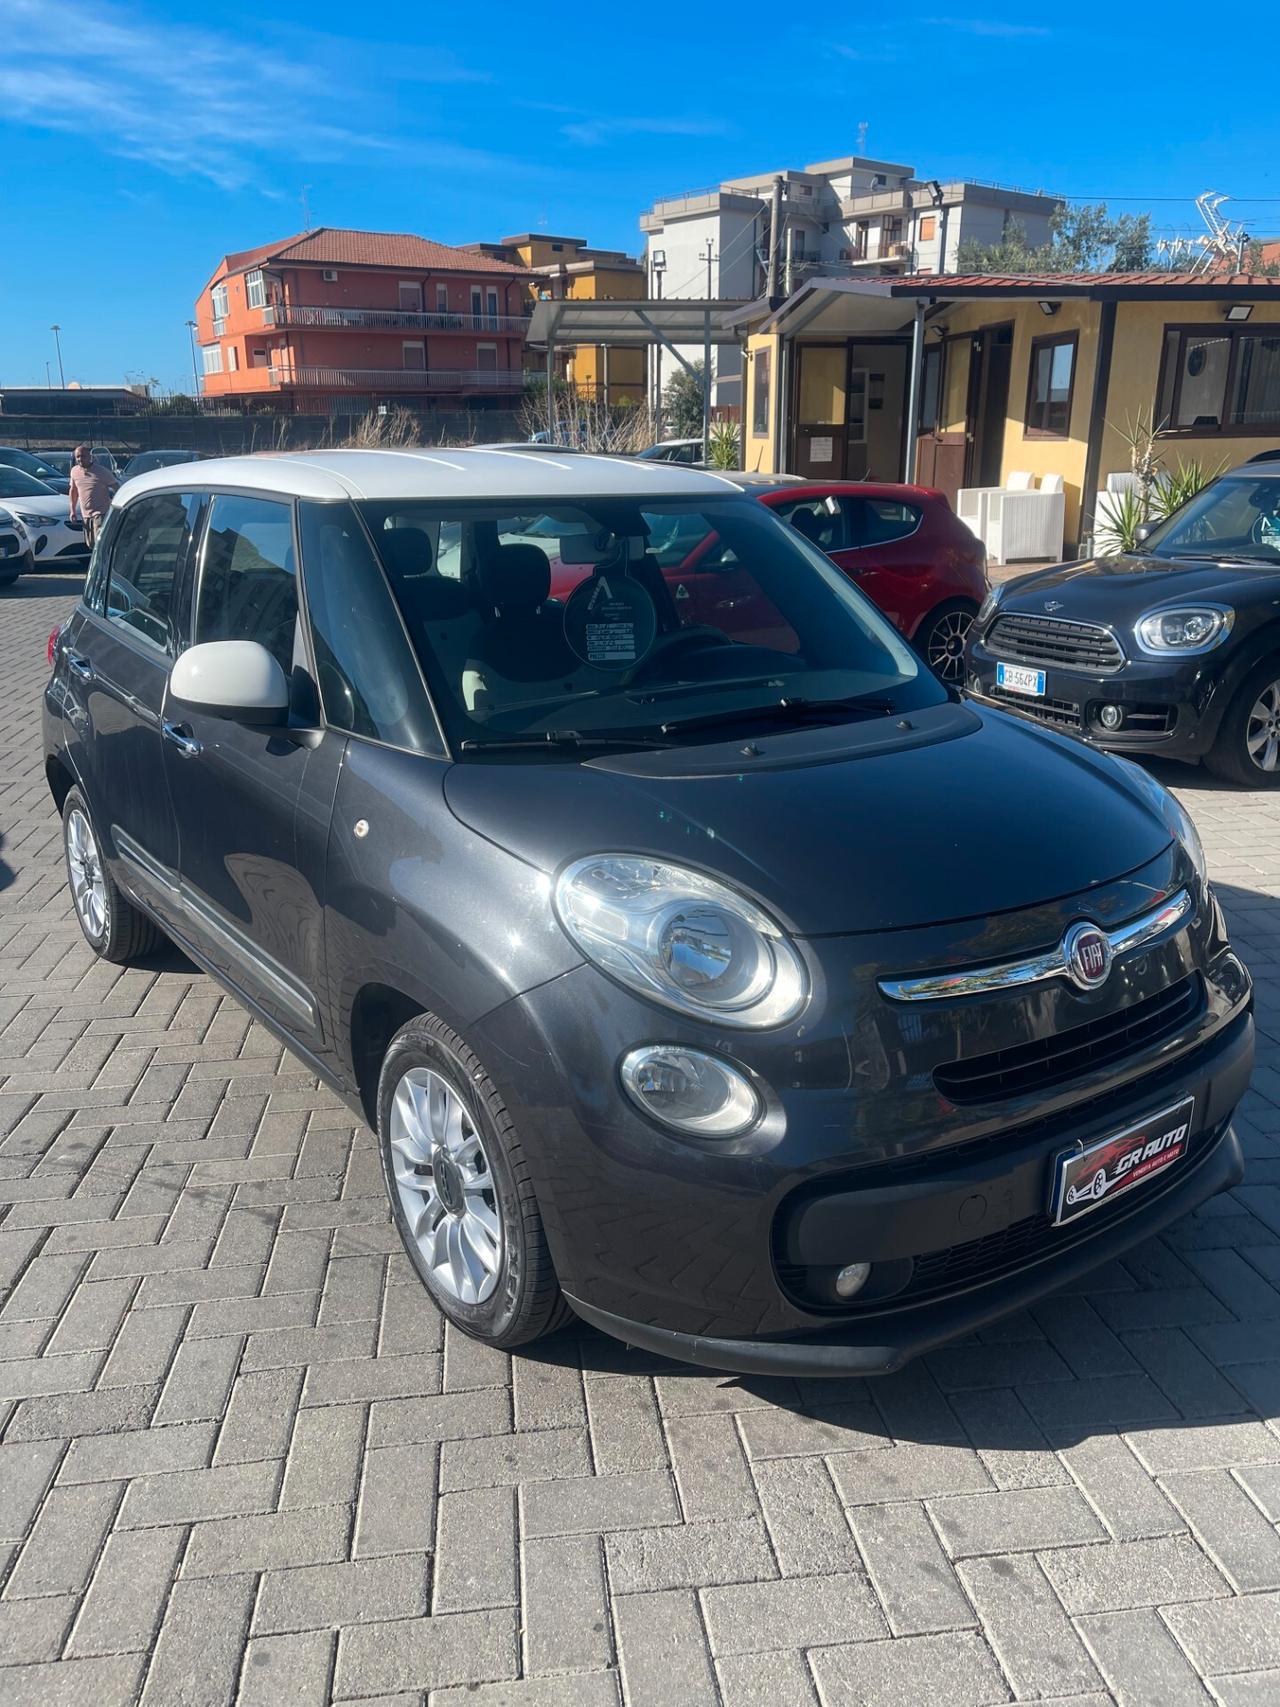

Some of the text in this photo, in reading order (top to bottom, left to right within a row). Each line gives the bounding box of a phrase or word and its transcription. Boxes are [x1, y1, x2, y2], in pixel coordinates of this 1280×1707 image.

[1081, 942, 1104, 971] FIAT
[1115, 1123, 1188, 1174] GR AUTO
